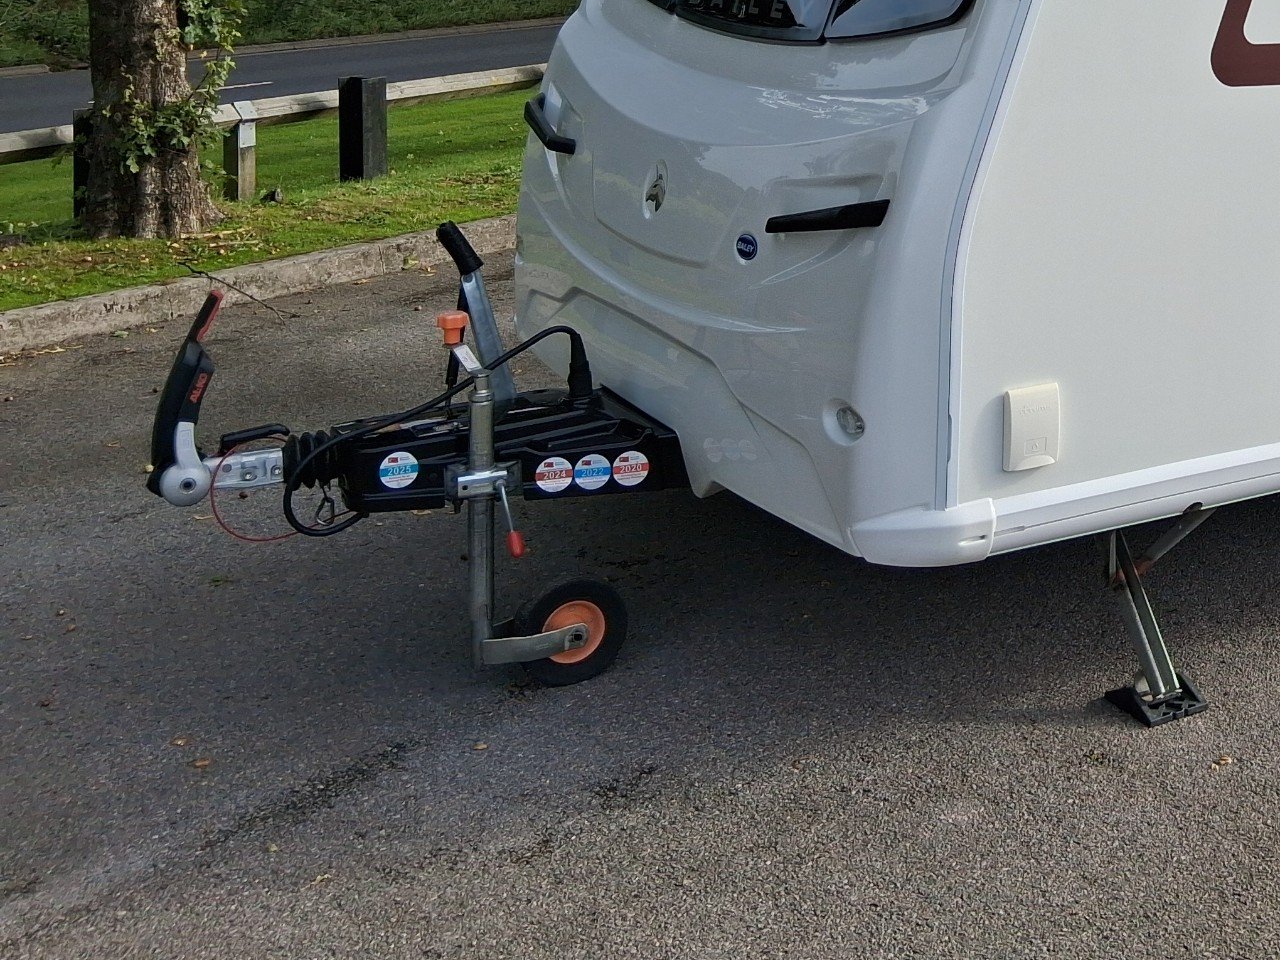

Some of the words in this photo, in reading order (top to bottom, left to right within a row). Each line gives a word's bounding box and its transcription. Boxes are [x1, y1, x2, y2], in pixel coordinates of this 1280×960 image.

[387, 465, 411, 476] 2025
[581, 468, 604, 477] 2022
[619, 464, 642, 474] 2020
[543, 470, 566, 480] 2024
